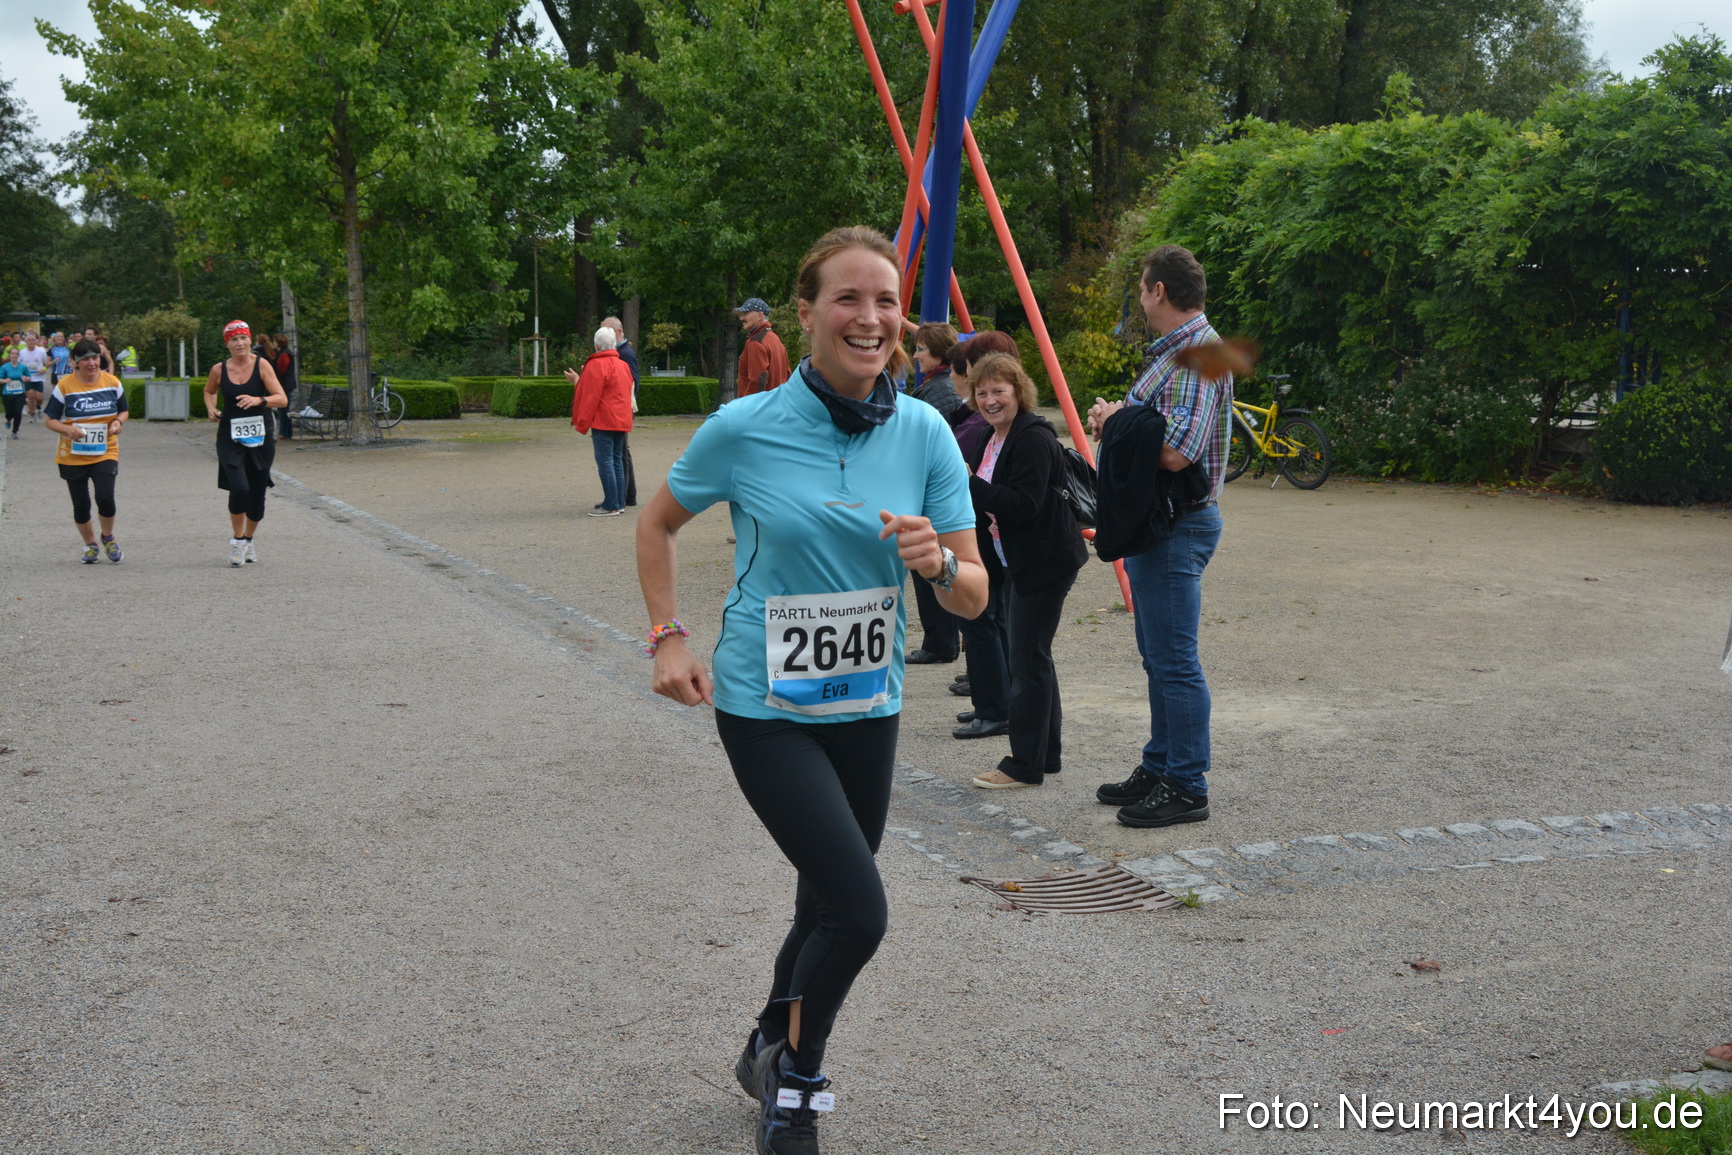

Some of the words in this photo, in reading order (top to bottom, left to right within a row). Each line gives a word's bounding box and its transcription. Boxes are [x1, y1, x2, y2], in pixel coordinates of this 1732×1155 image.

[80, 400, 112, 409] Fischer
[75, 431, 105, 443] 176
[235, 424, 262, 437] 3337
[769, 608, 817, 620] PARTL
[819, 602, 878, 619] Neumarkt
[782, 617, 886, 673] 2646
[822, 682, 849, 699] Eva
